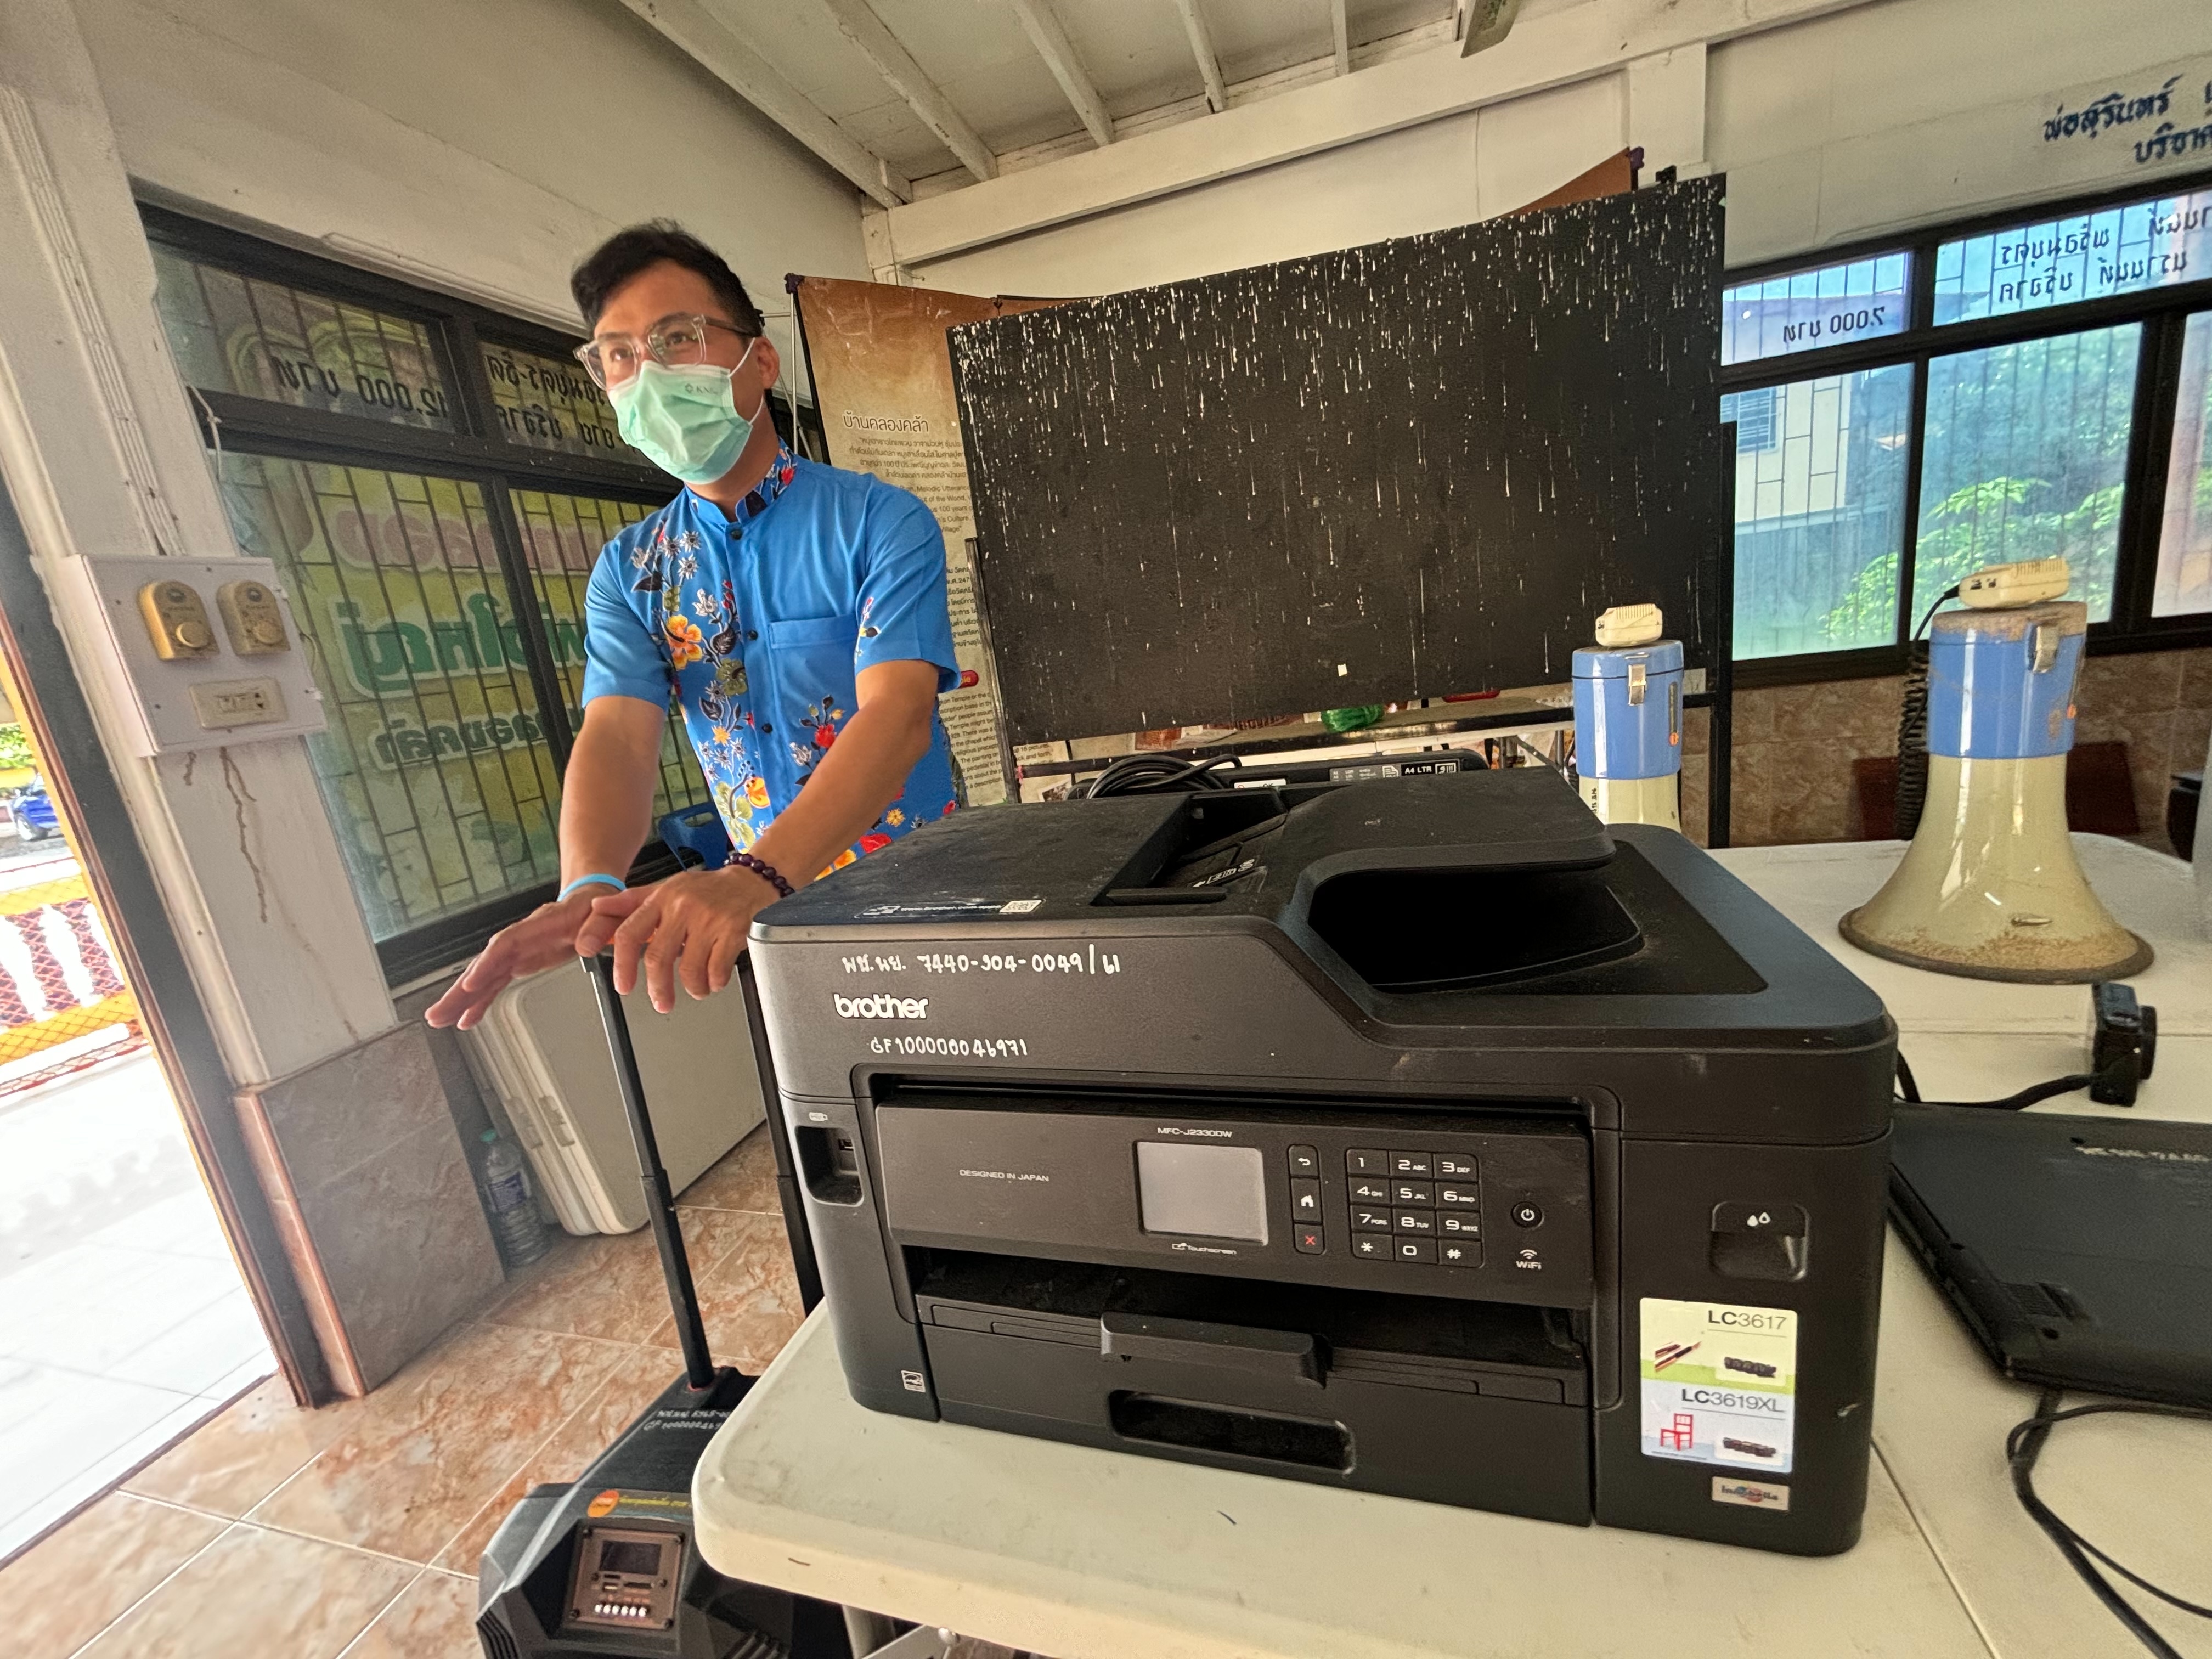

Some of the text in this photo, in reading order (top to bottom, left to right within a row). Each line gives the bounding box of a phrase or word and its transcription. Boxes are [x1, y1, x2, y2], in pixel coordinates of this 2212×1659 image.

[843, 410, 929, 432] บ้านคลองคล้า
[1404, 765, 1432, 775] A4 LTR
[833, 994, 929, 1019] brother
[1157, 1127, 1233, 1138] MFC-J2330DW
[1358, 1157, 1364, 1167] 1
[1398, 1159, 1410, 1170] 2
[1442, 1161, 1455, 1172] 3
[960, 1170, 1005, 1179] DESIGNED
[1018, 1173, 1049, 1182] JAPAN
[1357, 1186, 1370, 1196] 4
[1400, 1188, 1413, 1199] 5
[1443, 1190, 1458, 1201] 6
[1359, 1214, 1372, 1224] 7
[1401, 1217, 1415, 1227] 8
[1445, 1220, 1459, 1231] 9
[1187, 1244, 1237, 1255] Touchscreen
[1516, 1261, 1542, 1270] WiFi
[1708, 1310, 1787, 1330] LC3617
[1681, 1389, 1785, 1413] LC3619XL
